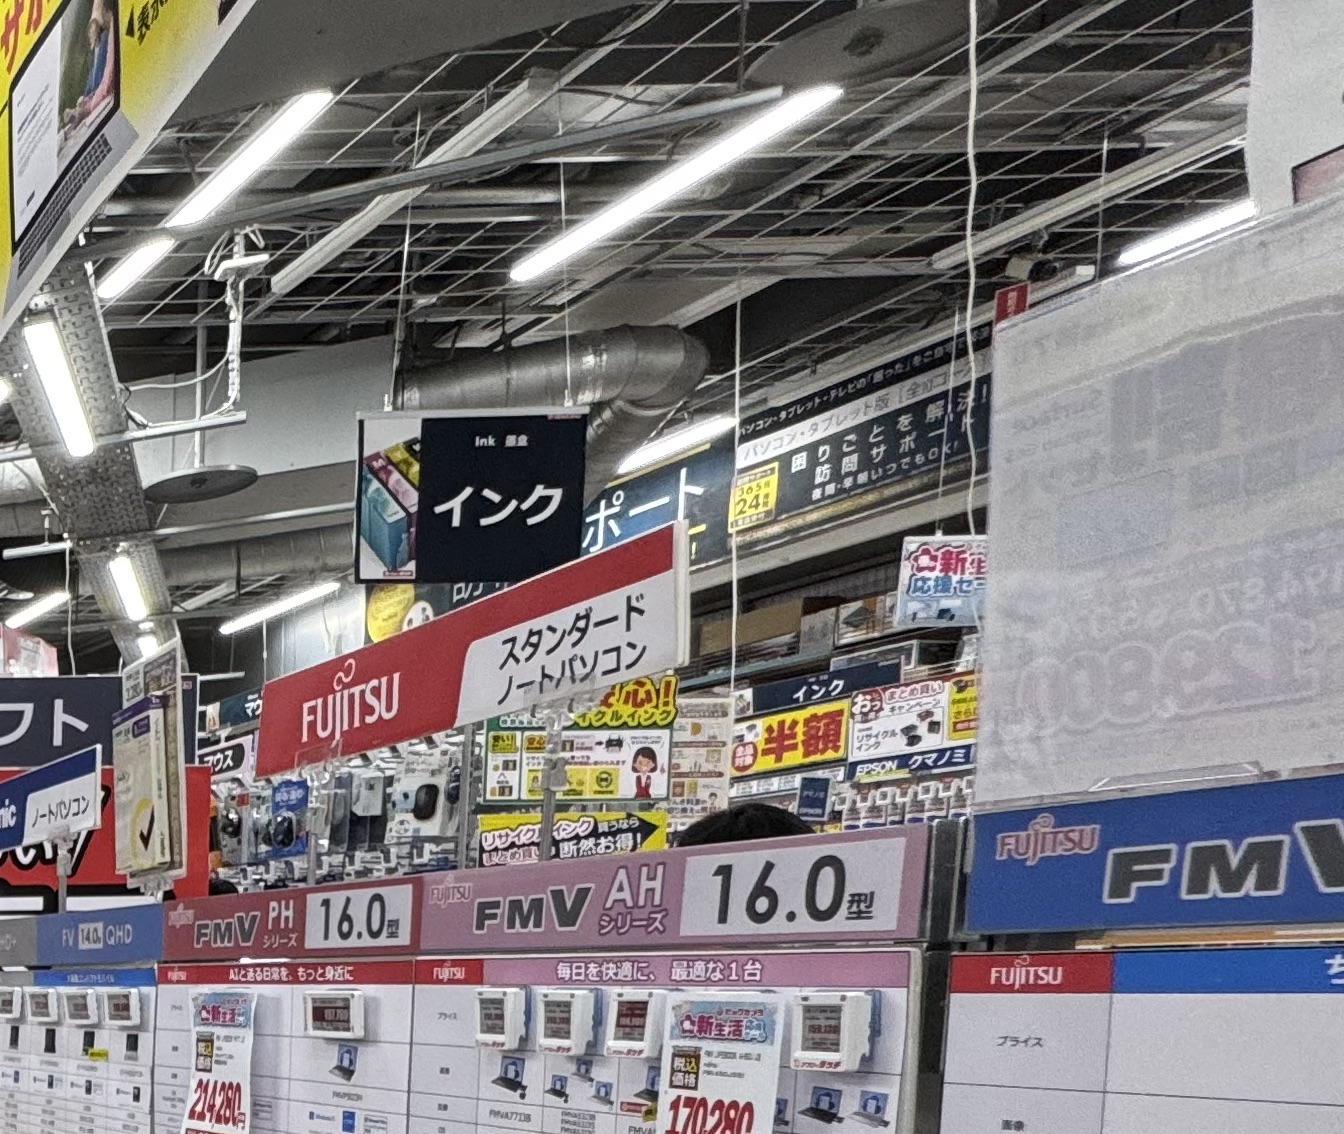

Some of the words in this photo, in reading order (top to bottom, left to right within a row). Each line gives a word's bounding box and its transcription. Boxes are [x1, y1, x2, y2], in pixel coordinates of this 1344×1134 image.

[474, 433, 496, 448] Ink
[433, 483, 565, 528] インク
[582, 466, 706, 555] ポート
[498, 590, 647, 671] スタンダード
[497, 641, 648, 706] ノートパソコン
[792, 678, 845, 703] インク
[300, 657, 402, 746] FUJITSU
[760, 707, 845, 764] 半額
[855, 759, 899, 777] EPSON
[907, 749, 966, 771] クマノミ
[30, 793, 90, 830] ノートパソコン
[995, 812, 1101, 867] FUJITSU
[472, 885, 596, 934] FMV
[604, 863, 668, 910] AH
[104, 924, 133, 946] QHD
[193, 910, 262, 948] FMV
[266, 902, 296, 931] PH
[262, 931, 299, 949] シリーズ
[598, 909, 668, 936] シリーズ
[432, 962, 467, 981] FUJITSU
[989, 954, 1064, 990] FUJITSU
[673, 1057, 697, 1073] 税込
